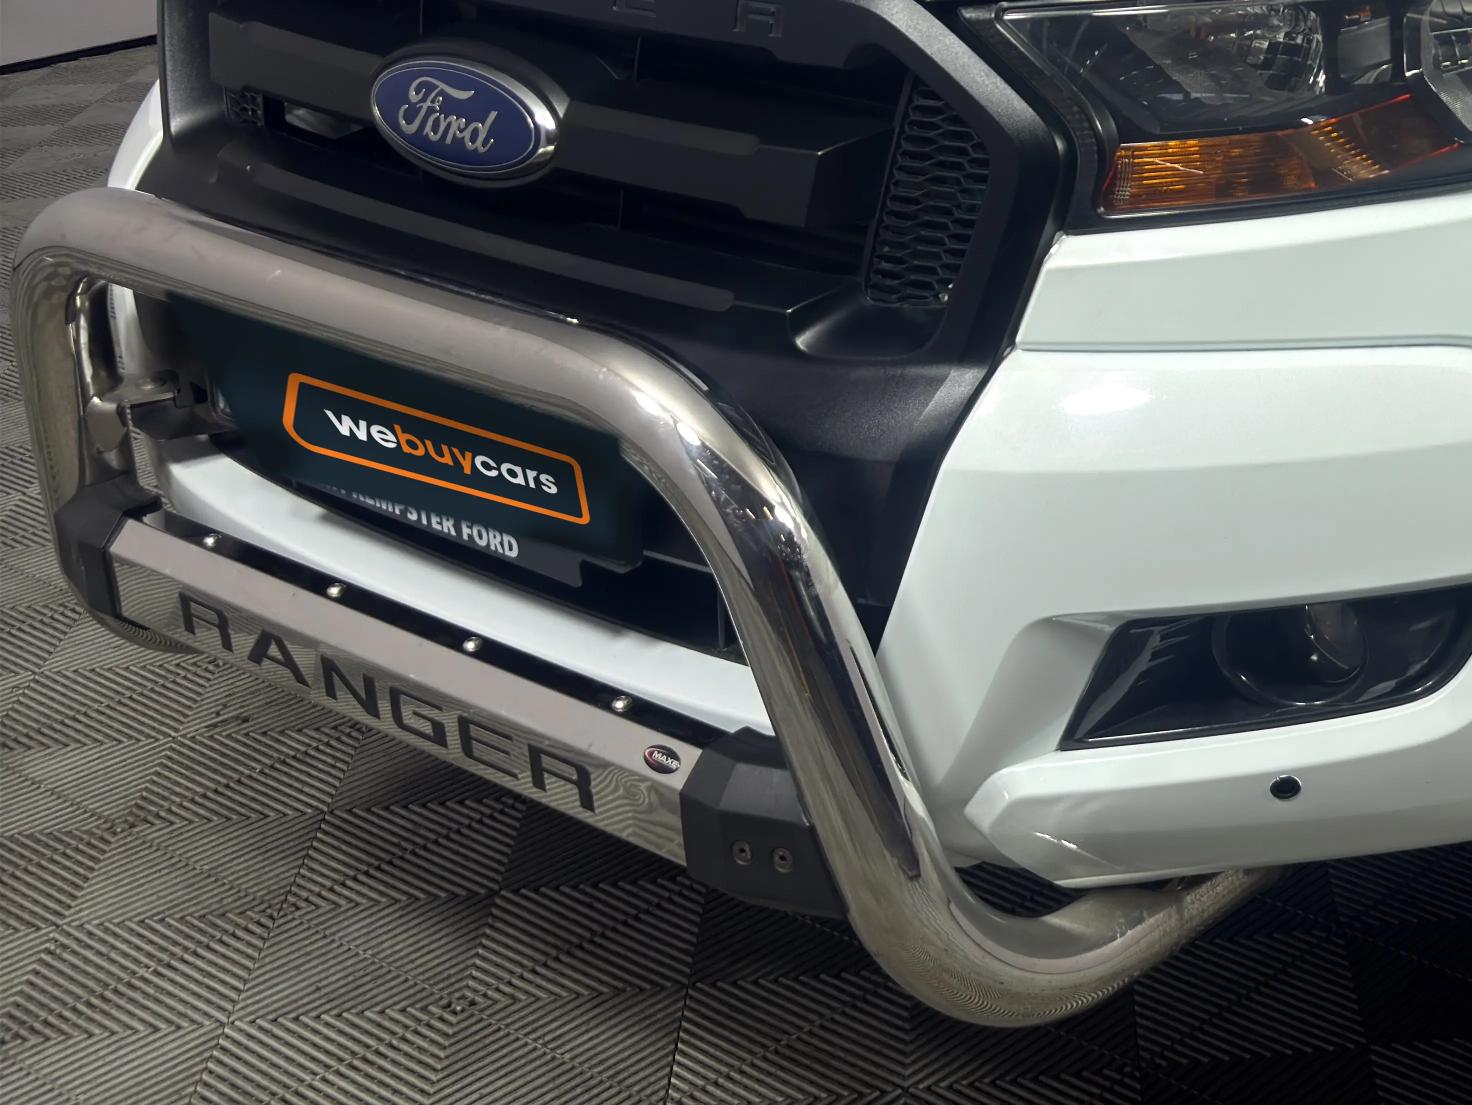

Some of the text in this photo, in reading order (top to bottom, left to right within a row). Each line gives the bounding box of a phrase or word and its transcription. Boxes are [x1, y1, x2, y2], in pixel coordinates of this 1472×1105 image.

[399, 76, 498, 153] Ford
[323, 408, 558, 494] webuycars
[461, 520, 519, 558] FORD
[178, 590, 597, 814] RANGER
